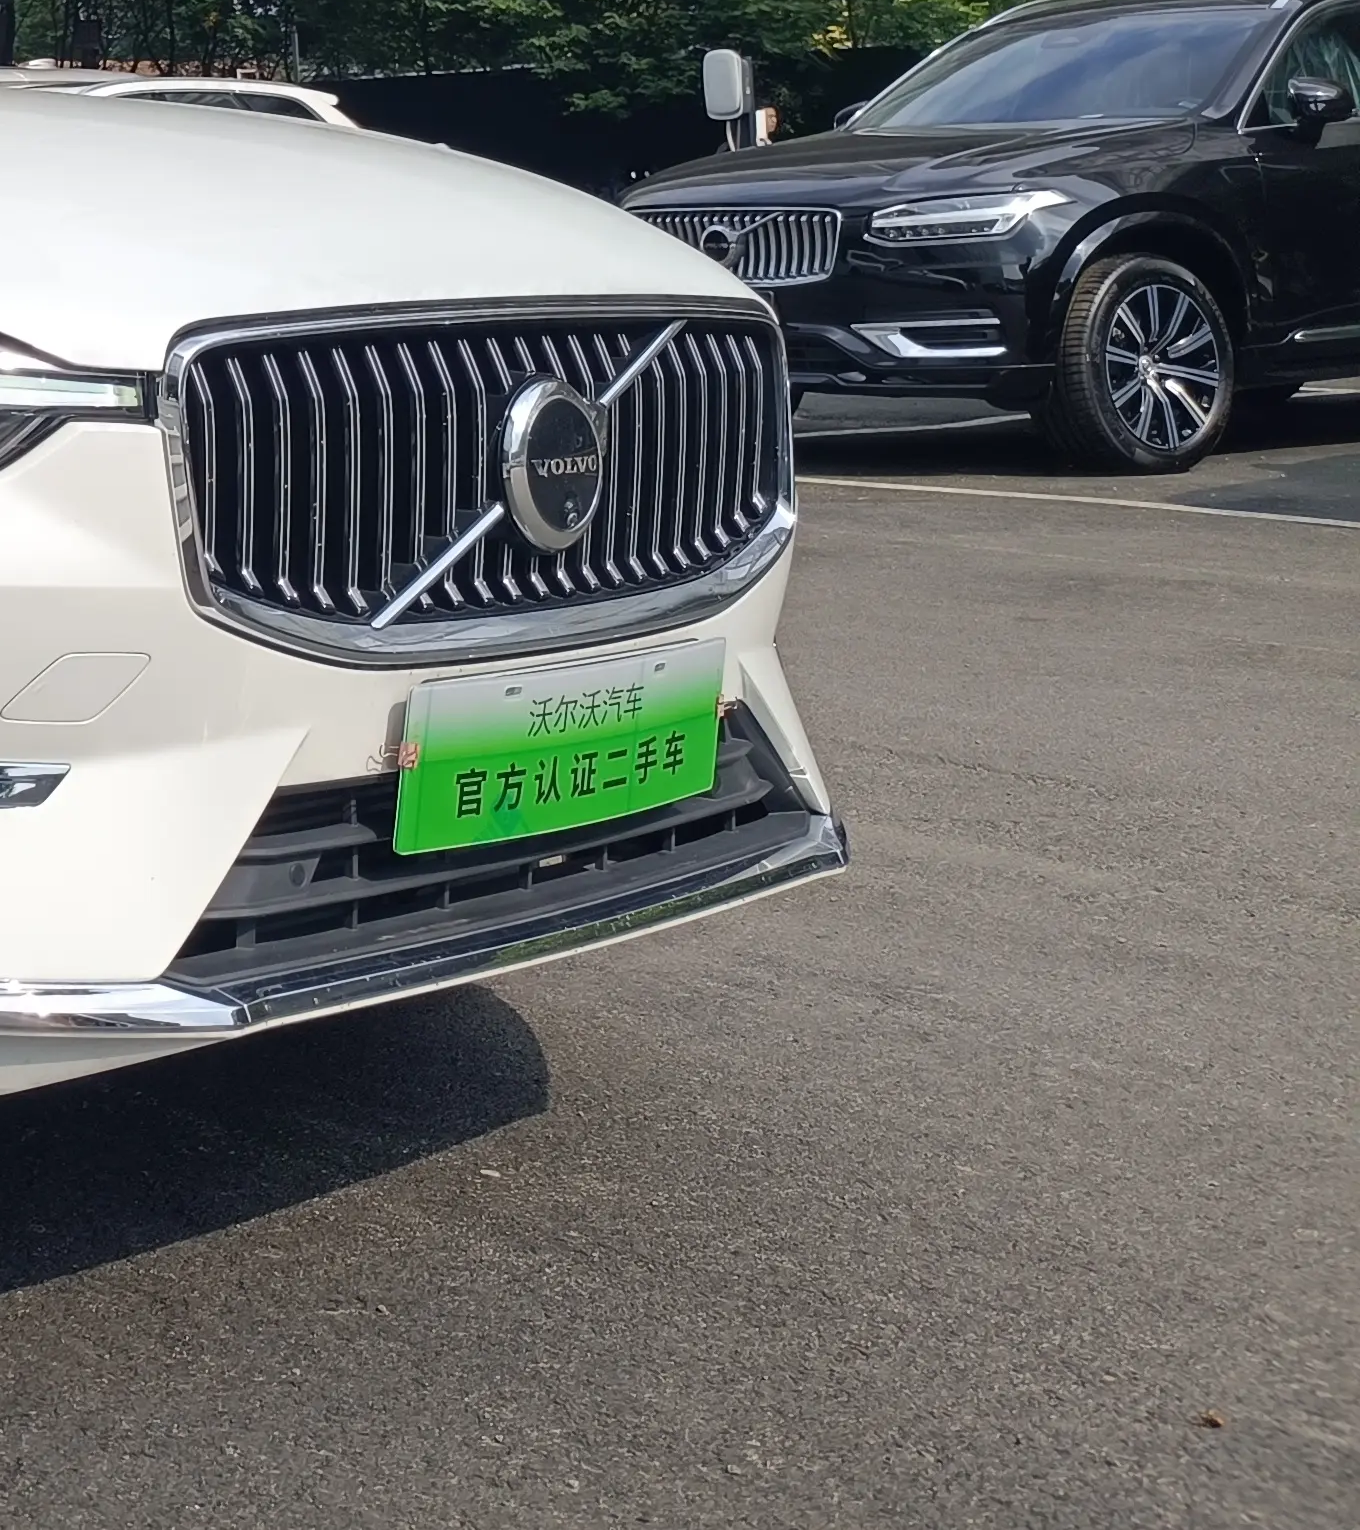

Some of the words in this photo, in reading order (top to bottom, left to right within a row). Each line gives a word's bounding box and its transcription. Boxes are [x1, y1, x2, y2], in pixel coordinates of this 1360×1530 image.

[531, 454, 597, 478] VOLVO
[527, 682, 645, 738] 沃尔沃汽车
[454, 730, 686, 819] 官方认证二手车
